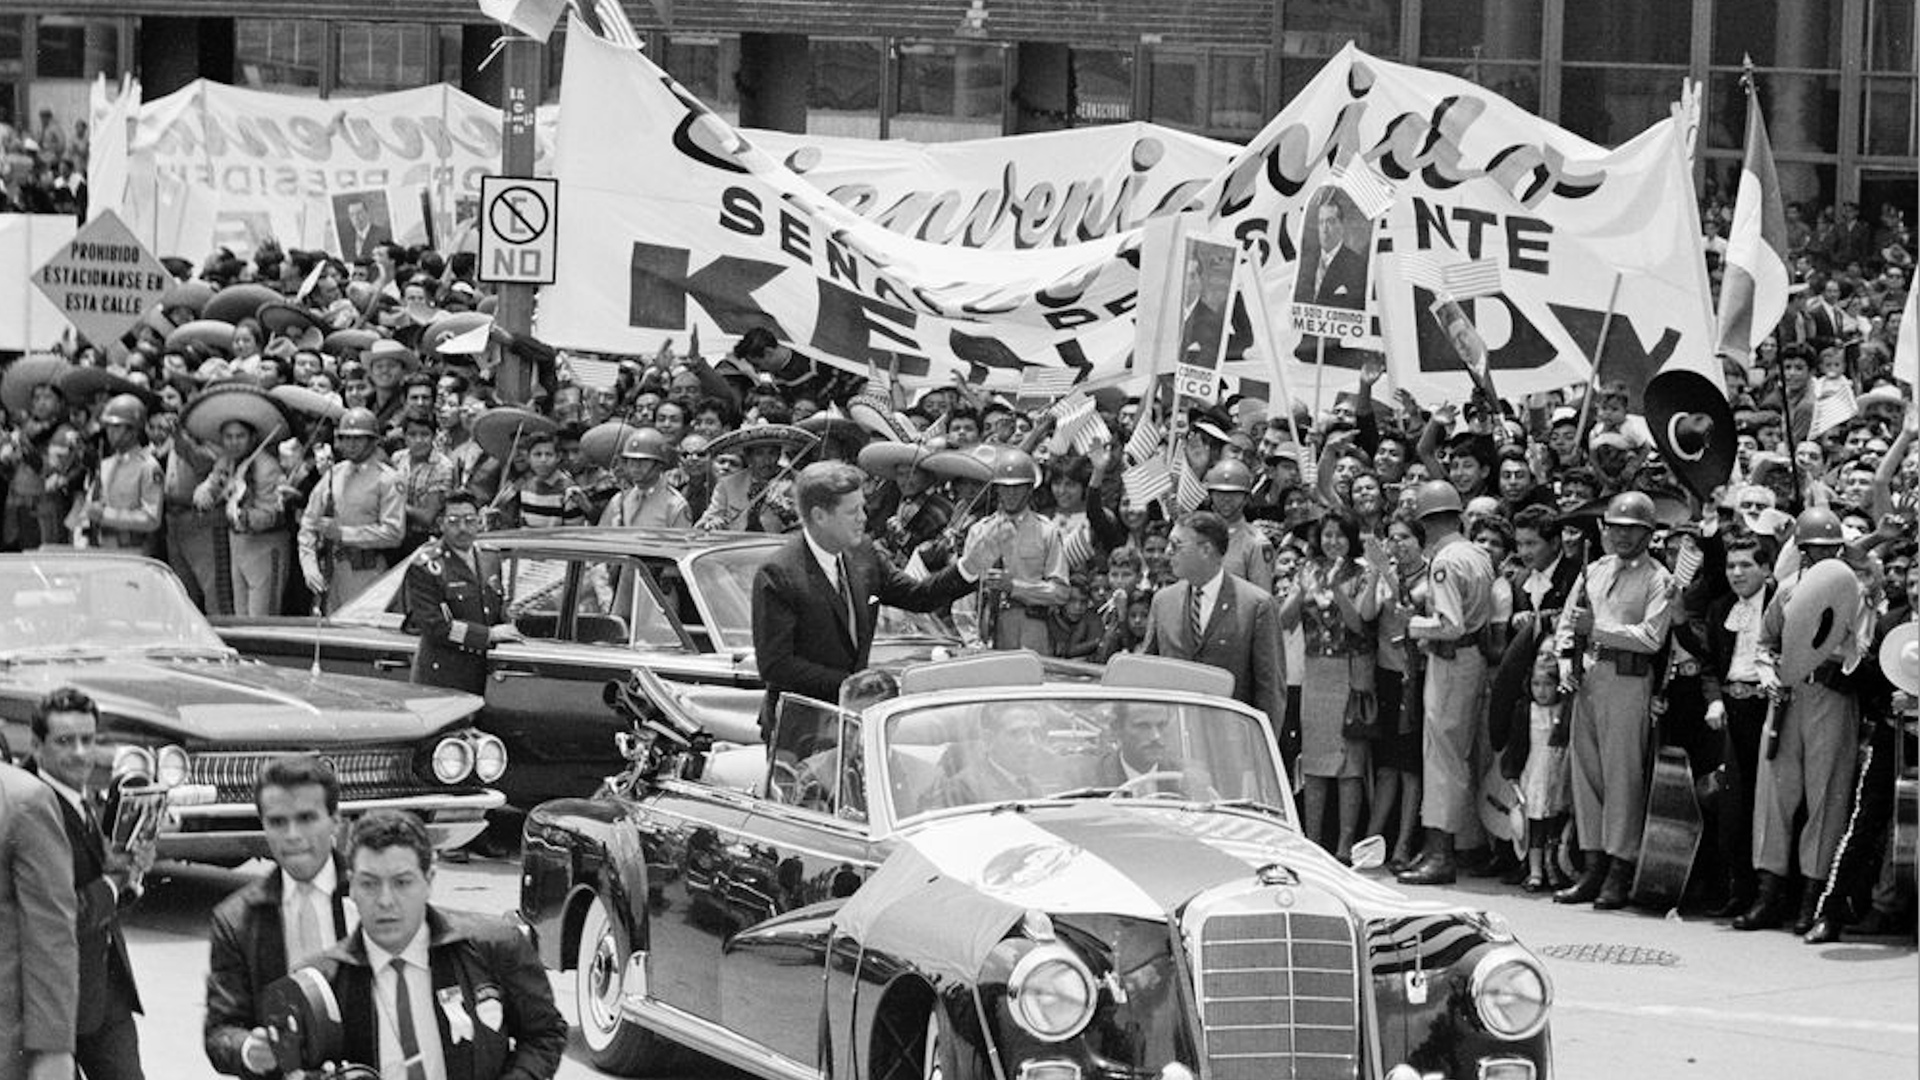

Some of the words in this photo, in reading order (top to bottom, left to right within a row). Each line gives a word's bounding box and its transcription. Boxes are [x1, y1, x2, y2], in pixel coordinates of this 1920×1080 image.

[71, 241, 140, 263] PROHIBIDO
[494, 248, 541, 276] NO
[43, 265, 142, 290] ESTACIONARSE
[147, 272, 164, 291] EN
[65, 293, 97, 312] ESTA
[102, 295, 141, 314] CALLE
[1294, 317, 1364, 338] MEXICO
[1181, 379, 1212, 396] ICO
